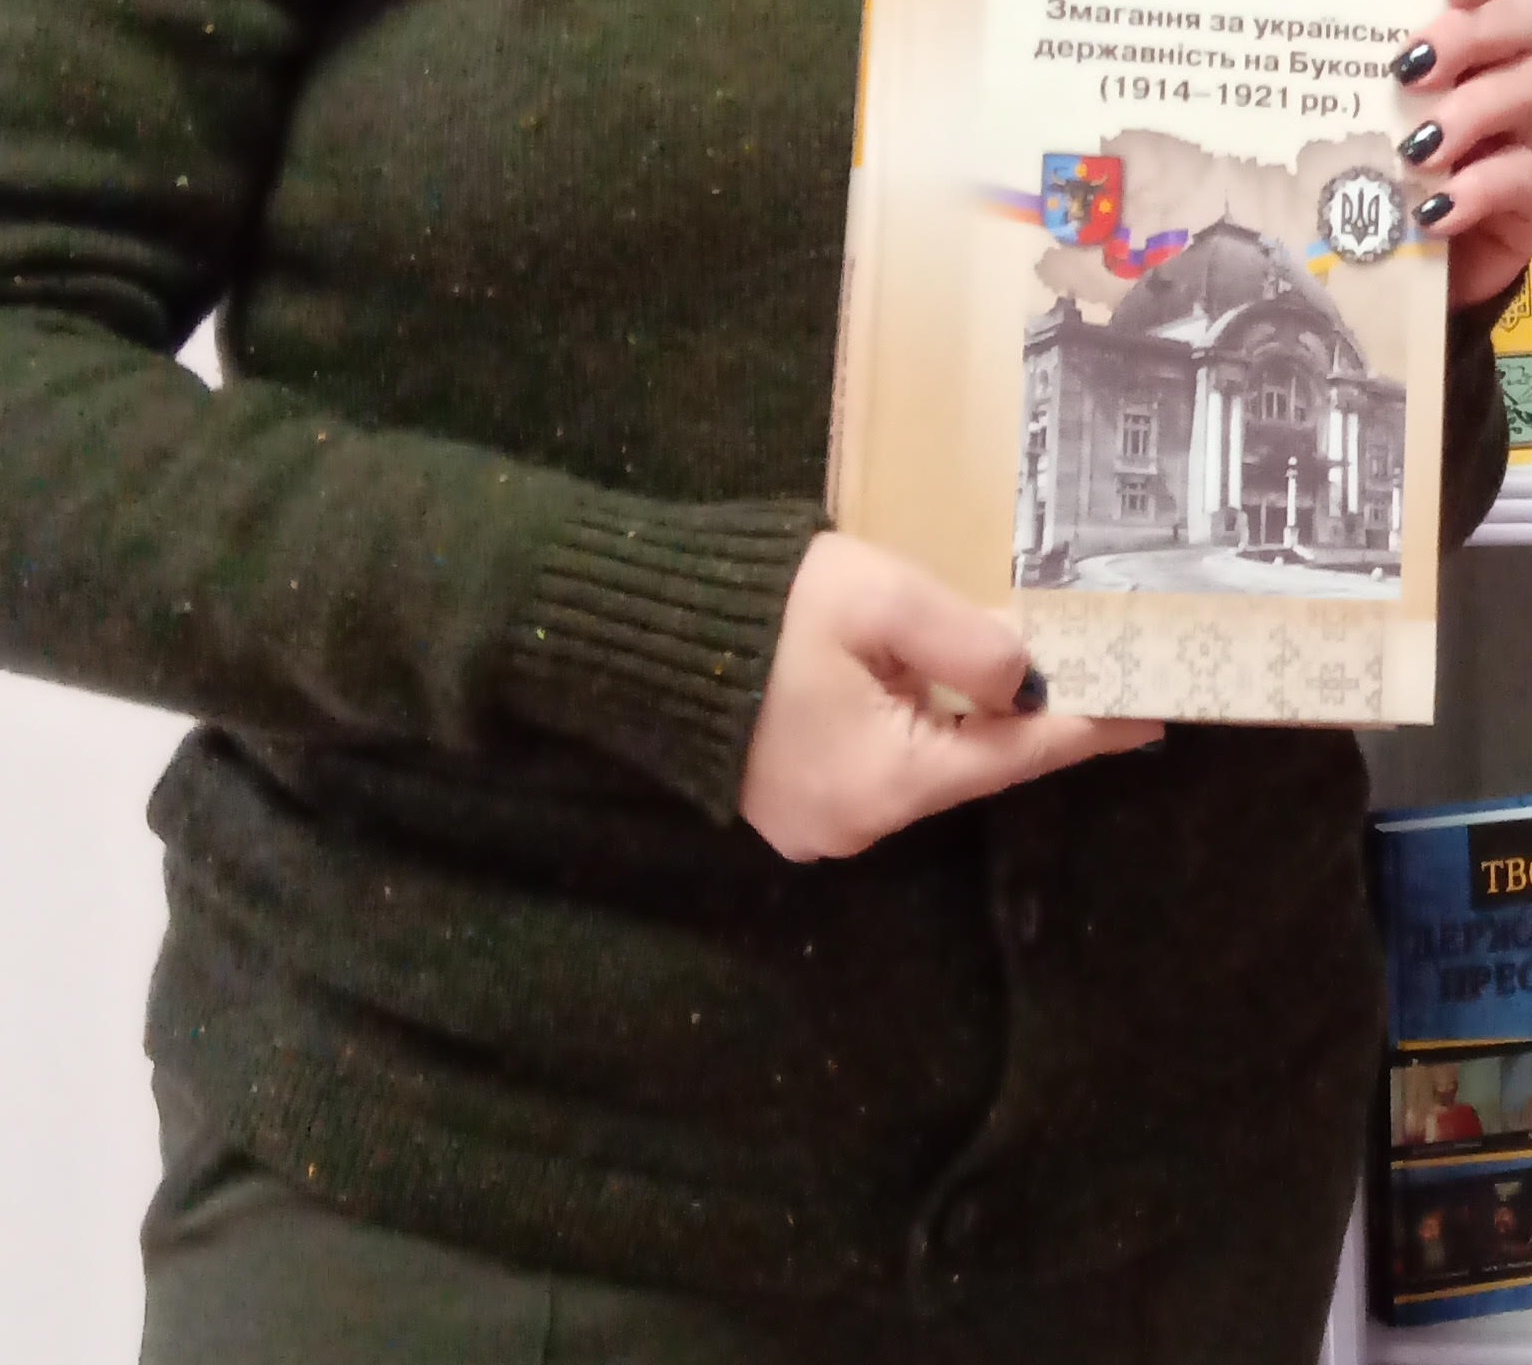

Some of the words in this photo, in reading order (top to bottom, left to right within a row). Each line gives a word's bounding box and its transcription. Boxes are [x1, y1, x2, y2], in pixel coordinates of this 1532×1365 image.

[1210, 13, 1244, 34] за
[1034, 38, 1236, 71] державність
[1244, 54, 1280, 74] на
[1301, 93, 1362, 119] рр.)
